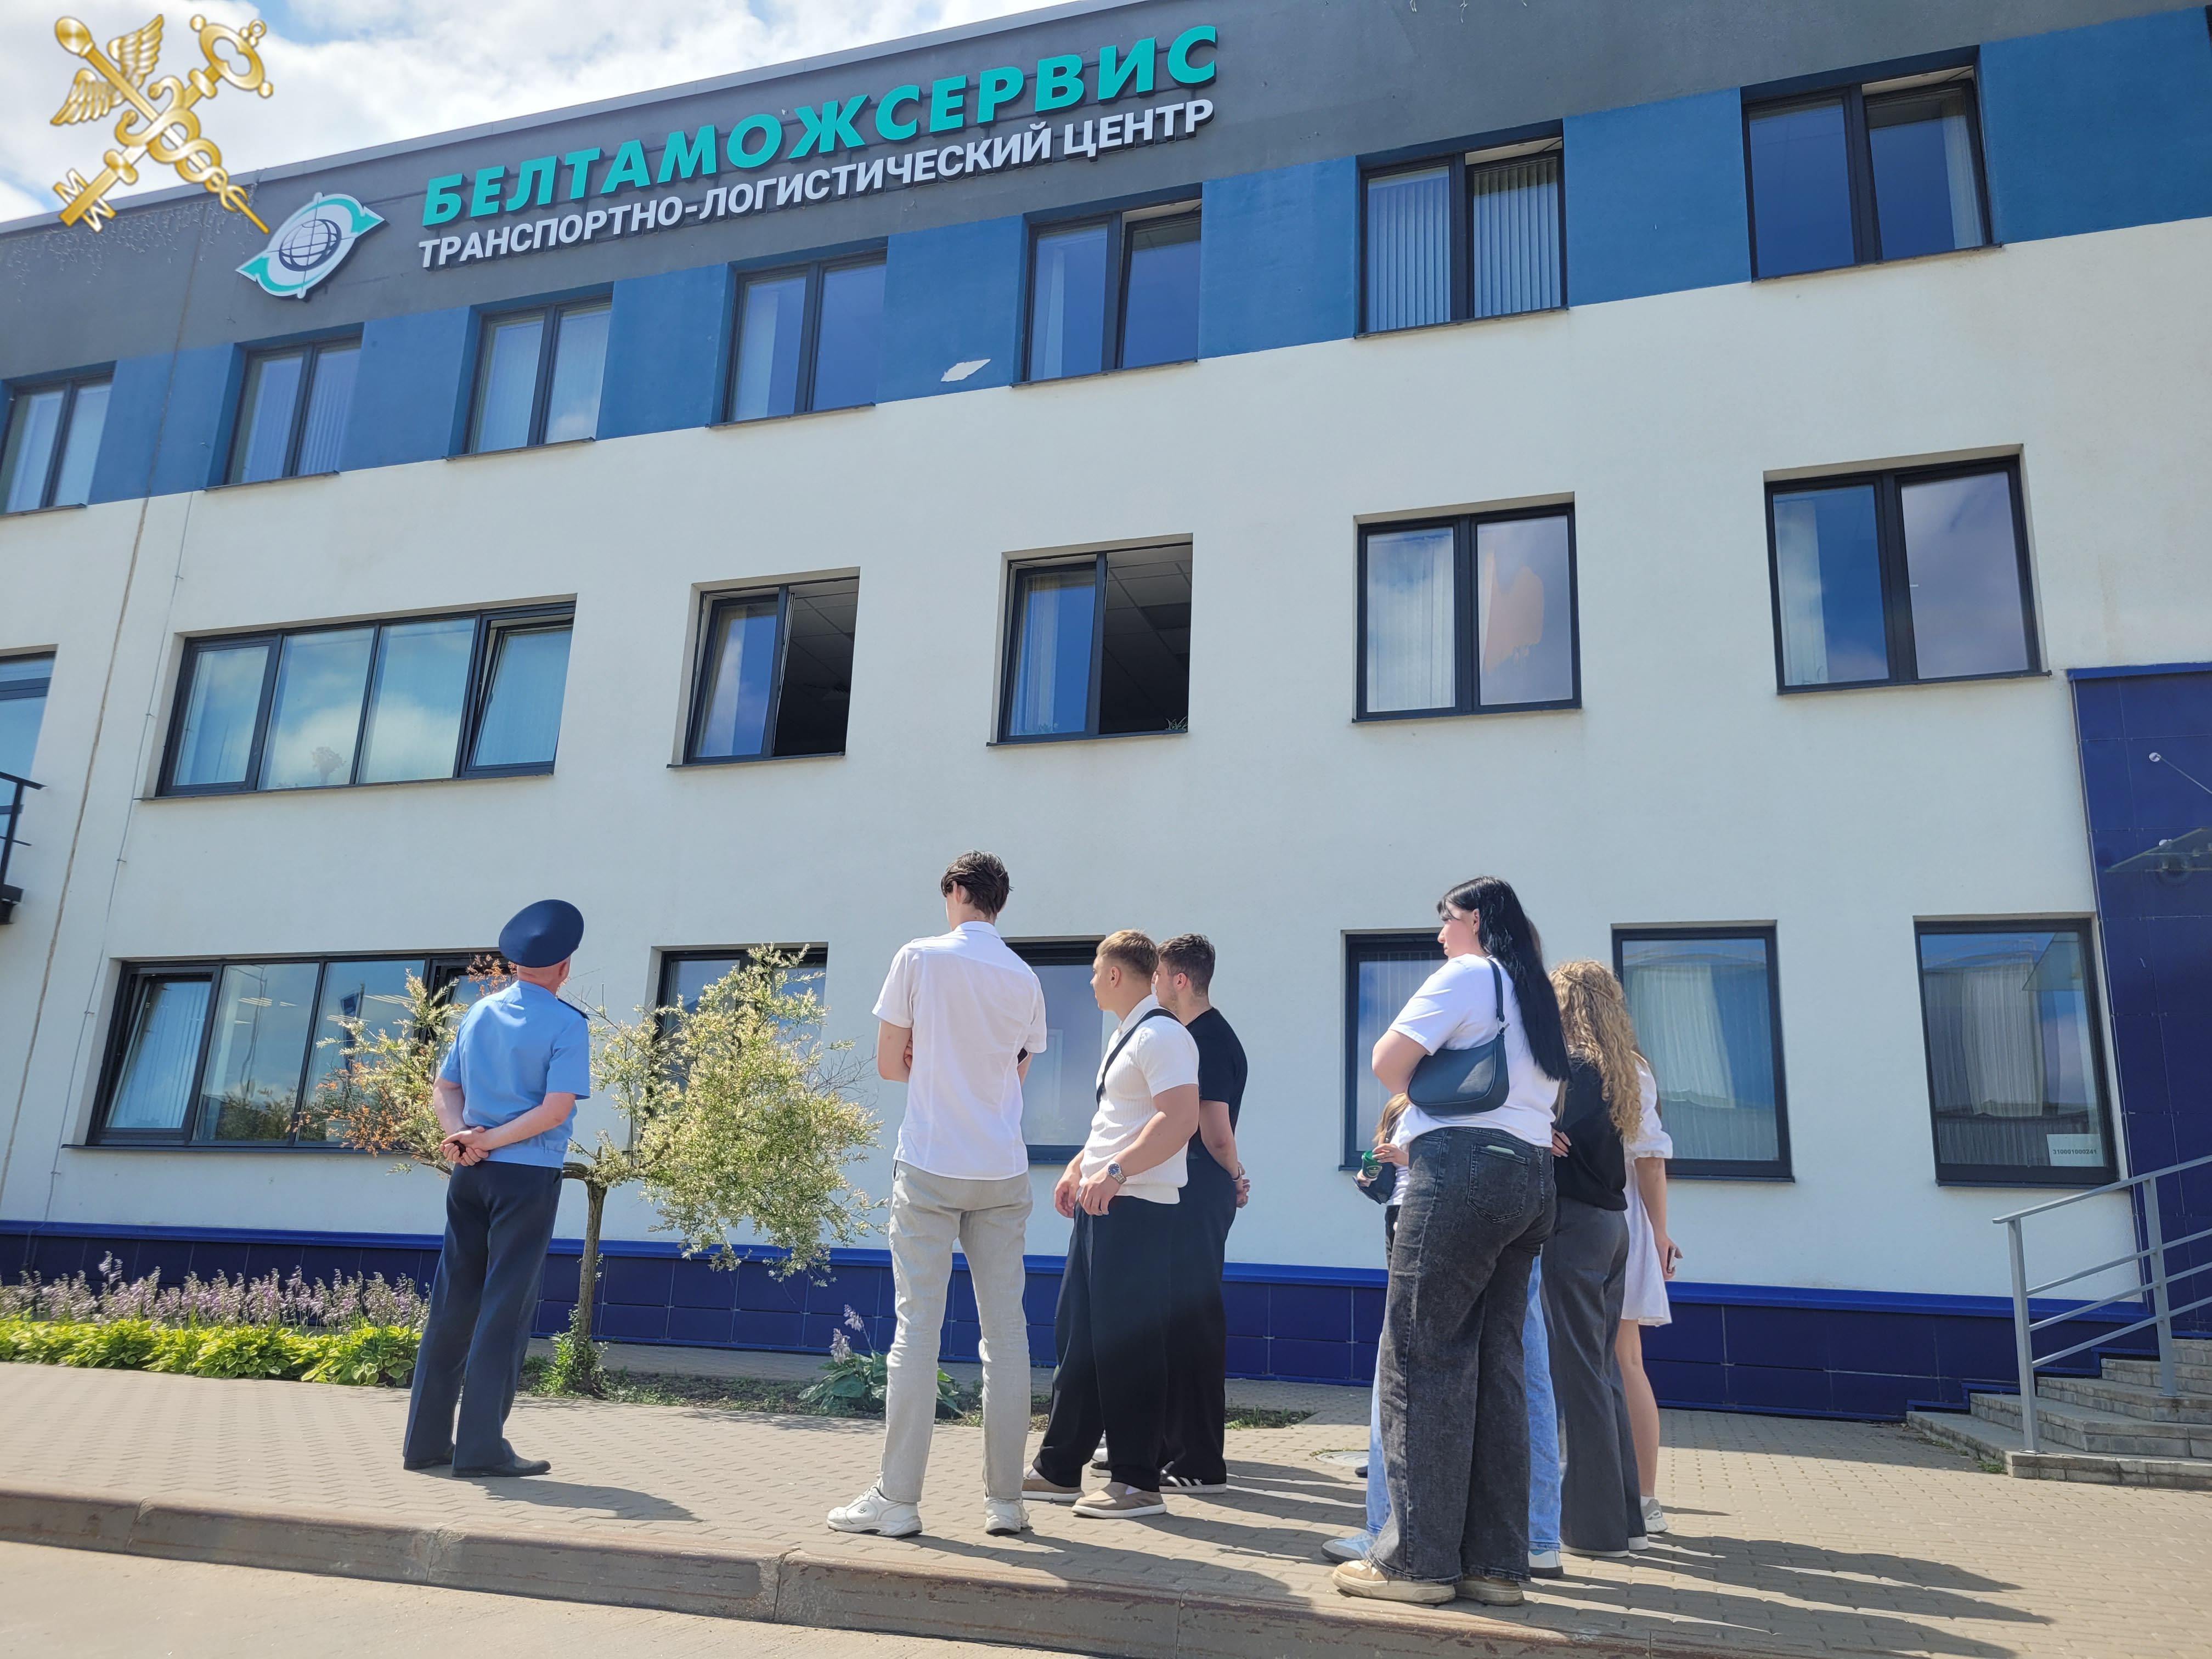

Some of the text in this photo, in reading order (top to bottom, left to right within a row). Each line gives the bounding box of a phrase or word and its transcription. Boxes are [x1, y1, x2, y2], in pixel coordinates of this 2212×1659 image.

[419, 99, 1214, 268] ТРАНСПОРТНО-ЛОГИСТИЧЕСКИЙ ЦЕНТР
[422, 25, 1217, 226] БЕЛТАМОЖСЕРВИС
